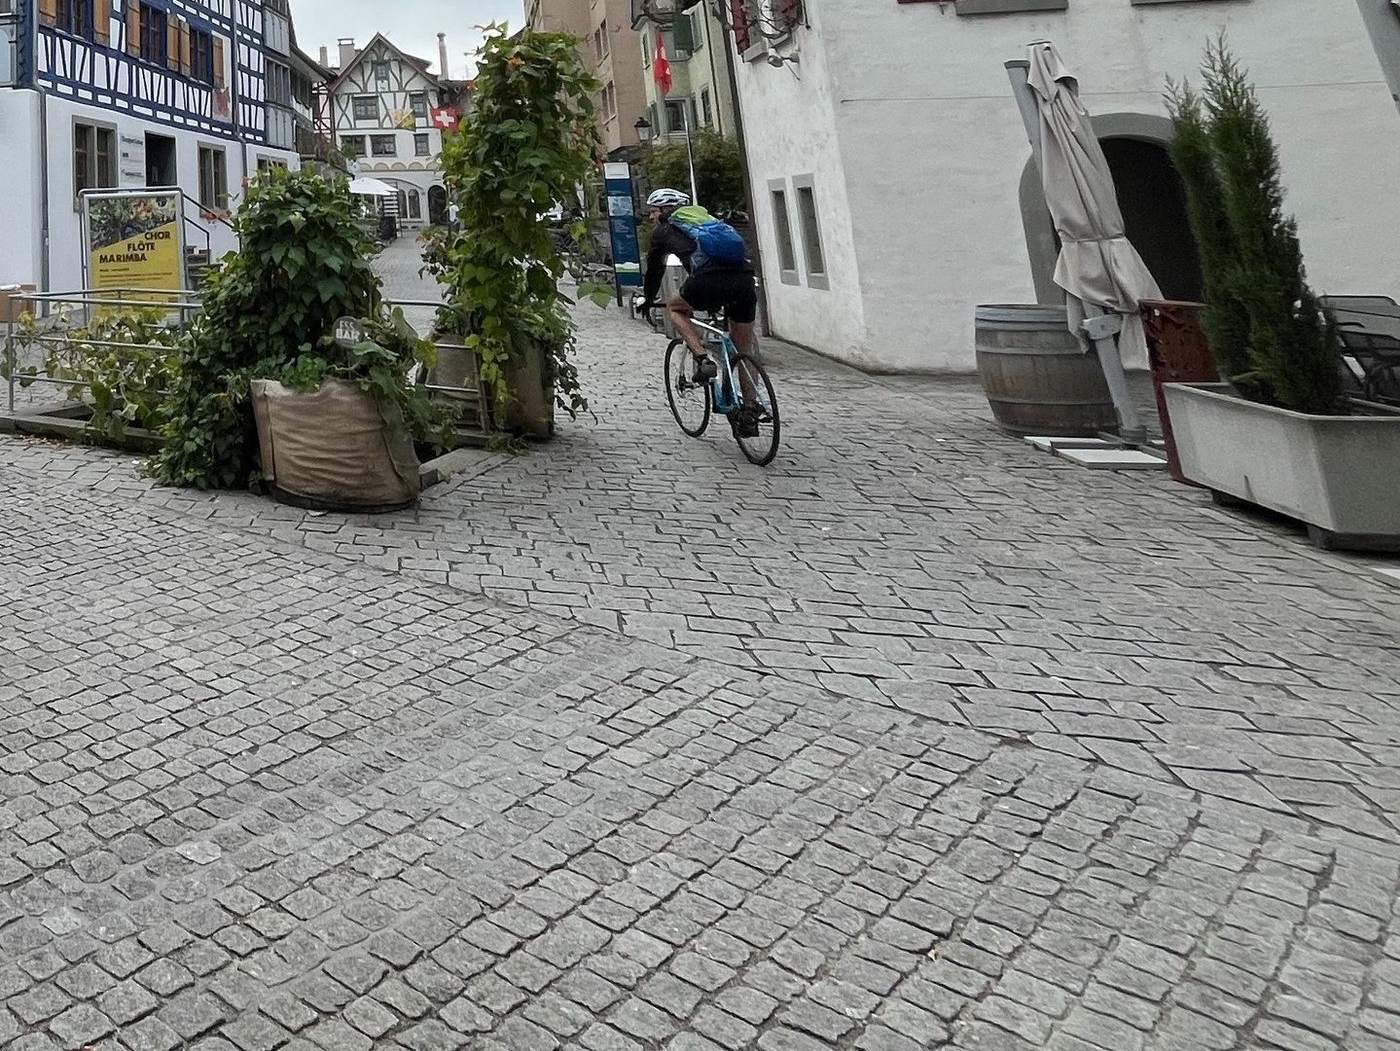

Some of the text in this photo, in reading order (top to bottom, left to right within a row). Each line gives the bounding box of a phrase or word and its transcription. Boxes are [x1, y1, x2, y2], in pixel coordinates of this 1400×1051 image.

[144, 231, 171, 240] CHOR
[99, 253, 147, 263] MARIMBA
[336, 329, 360, 342] BAR
